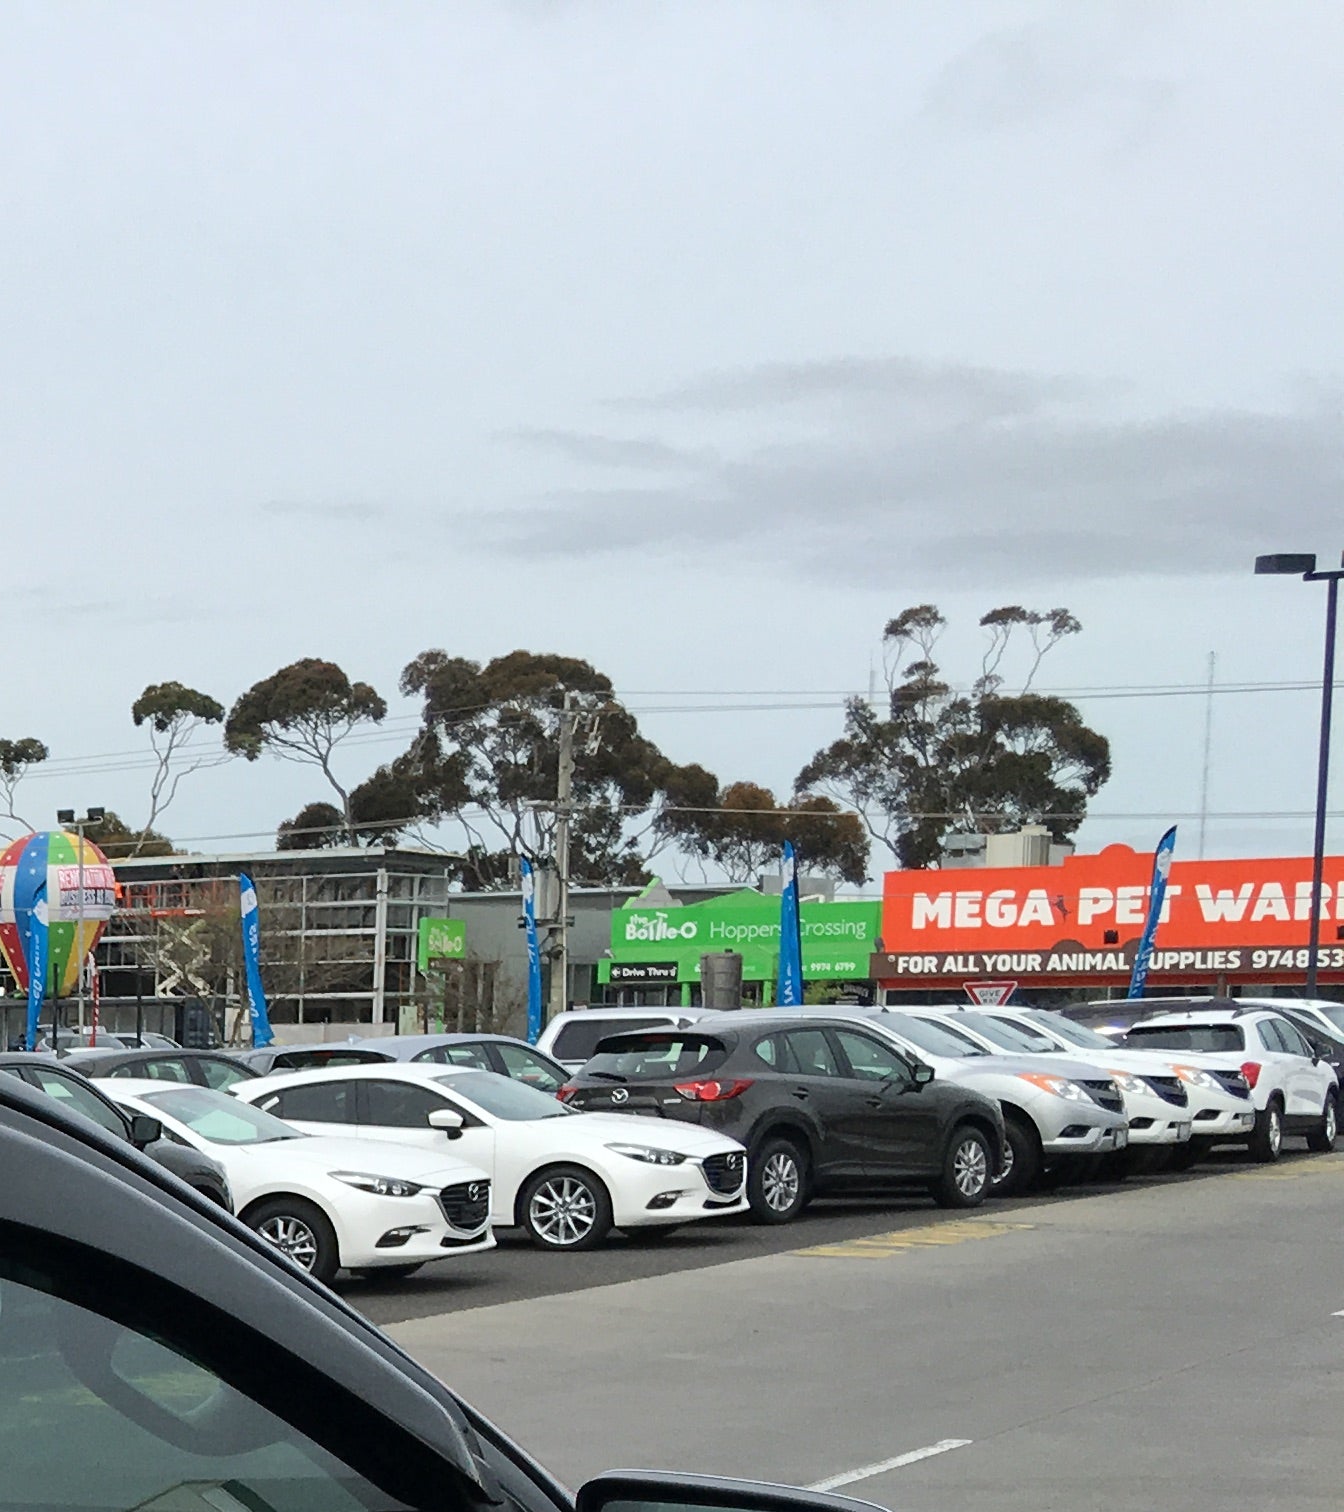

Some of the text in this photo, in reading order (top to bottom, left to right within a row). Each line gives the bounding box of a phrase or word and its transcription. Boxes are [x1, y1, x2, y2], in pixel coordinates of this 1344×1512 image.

[912, 889, 1055, 929] MEGA
[1077, 886, 1181, 926] PET
[897, 955, 938, 973] FOR
[942, 954, 980, 973] ALL
[981, 953, 1041, 972] YOUR
[1046, 951, 1129, 971] ANIMAL
[1135, 950, 1241, 970] UPPLIES
[1252, 950, 1309, 969] 9748
[622, 966, 668, 977] Drive Thru
[979, 990, 1001, 998] GIVE
